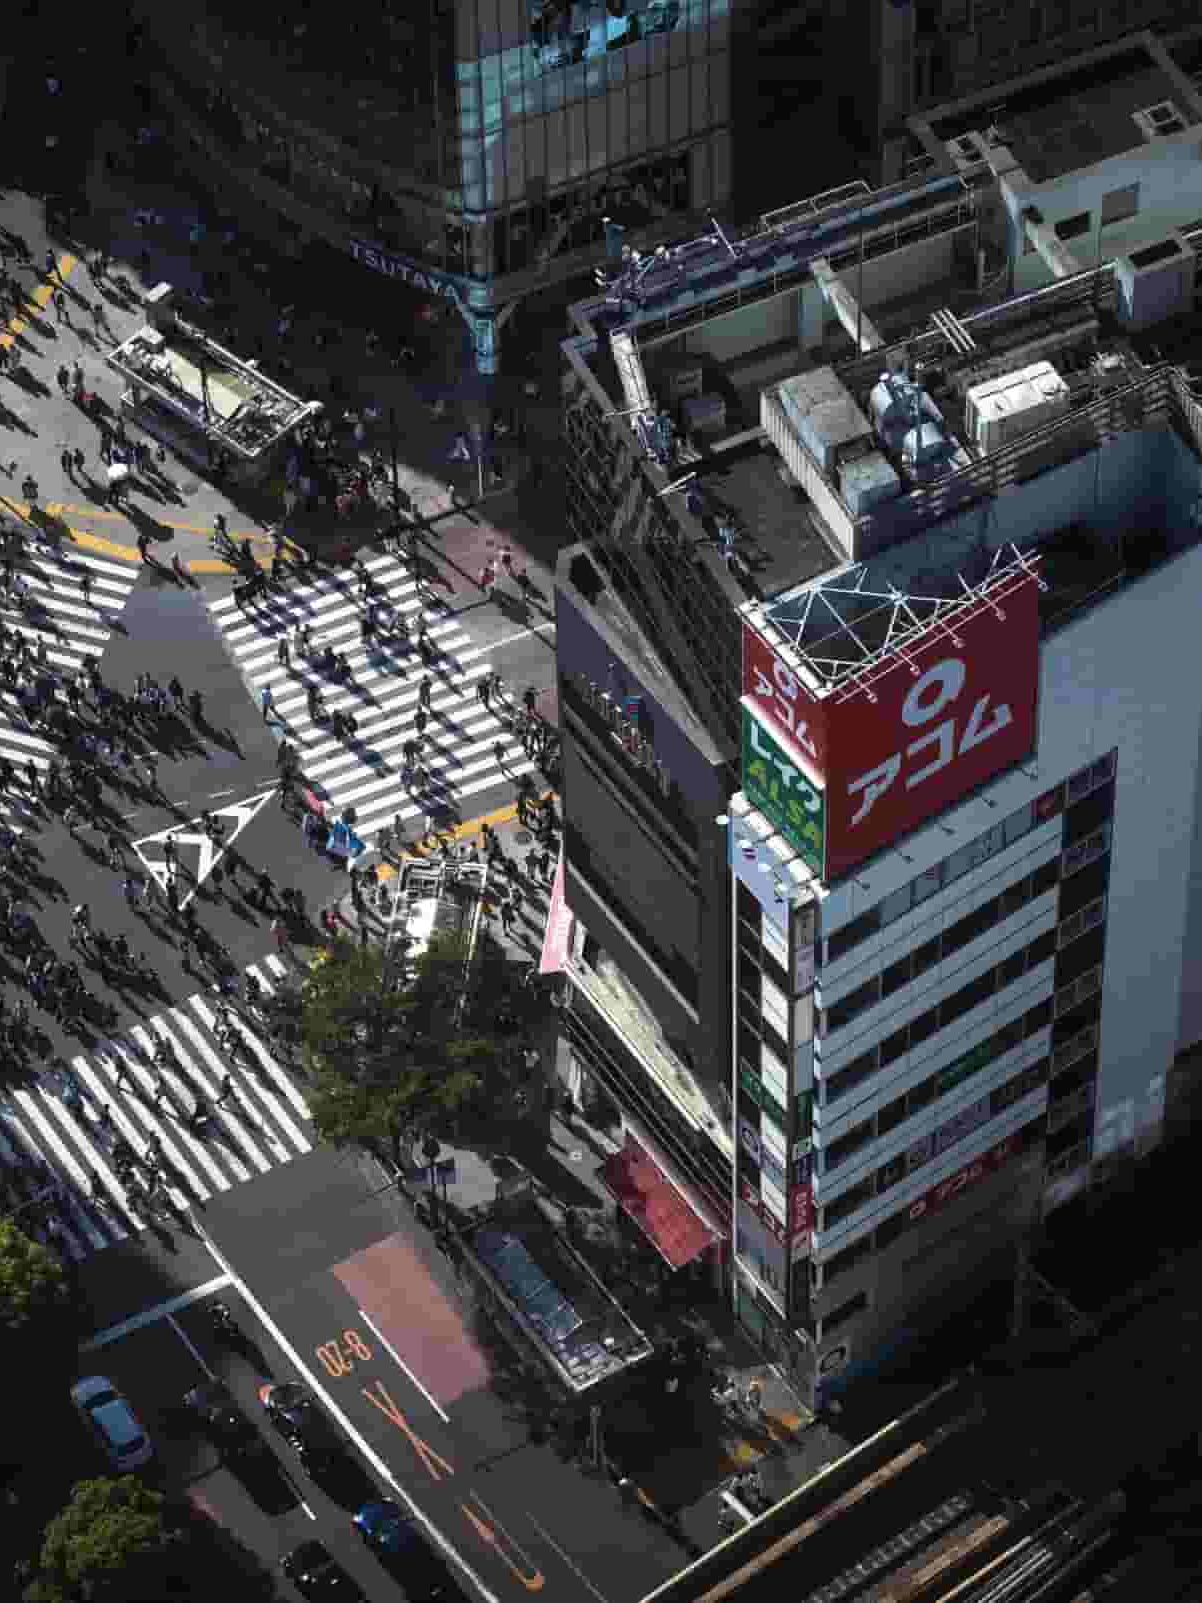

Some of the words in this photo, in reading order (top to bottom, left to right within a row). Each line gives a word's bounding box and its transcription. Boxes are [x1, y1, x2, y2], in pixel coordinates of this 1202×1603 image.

[350, 240, 462, 310] TSUTAYA
[847, 694, 1013, 831] アコム
